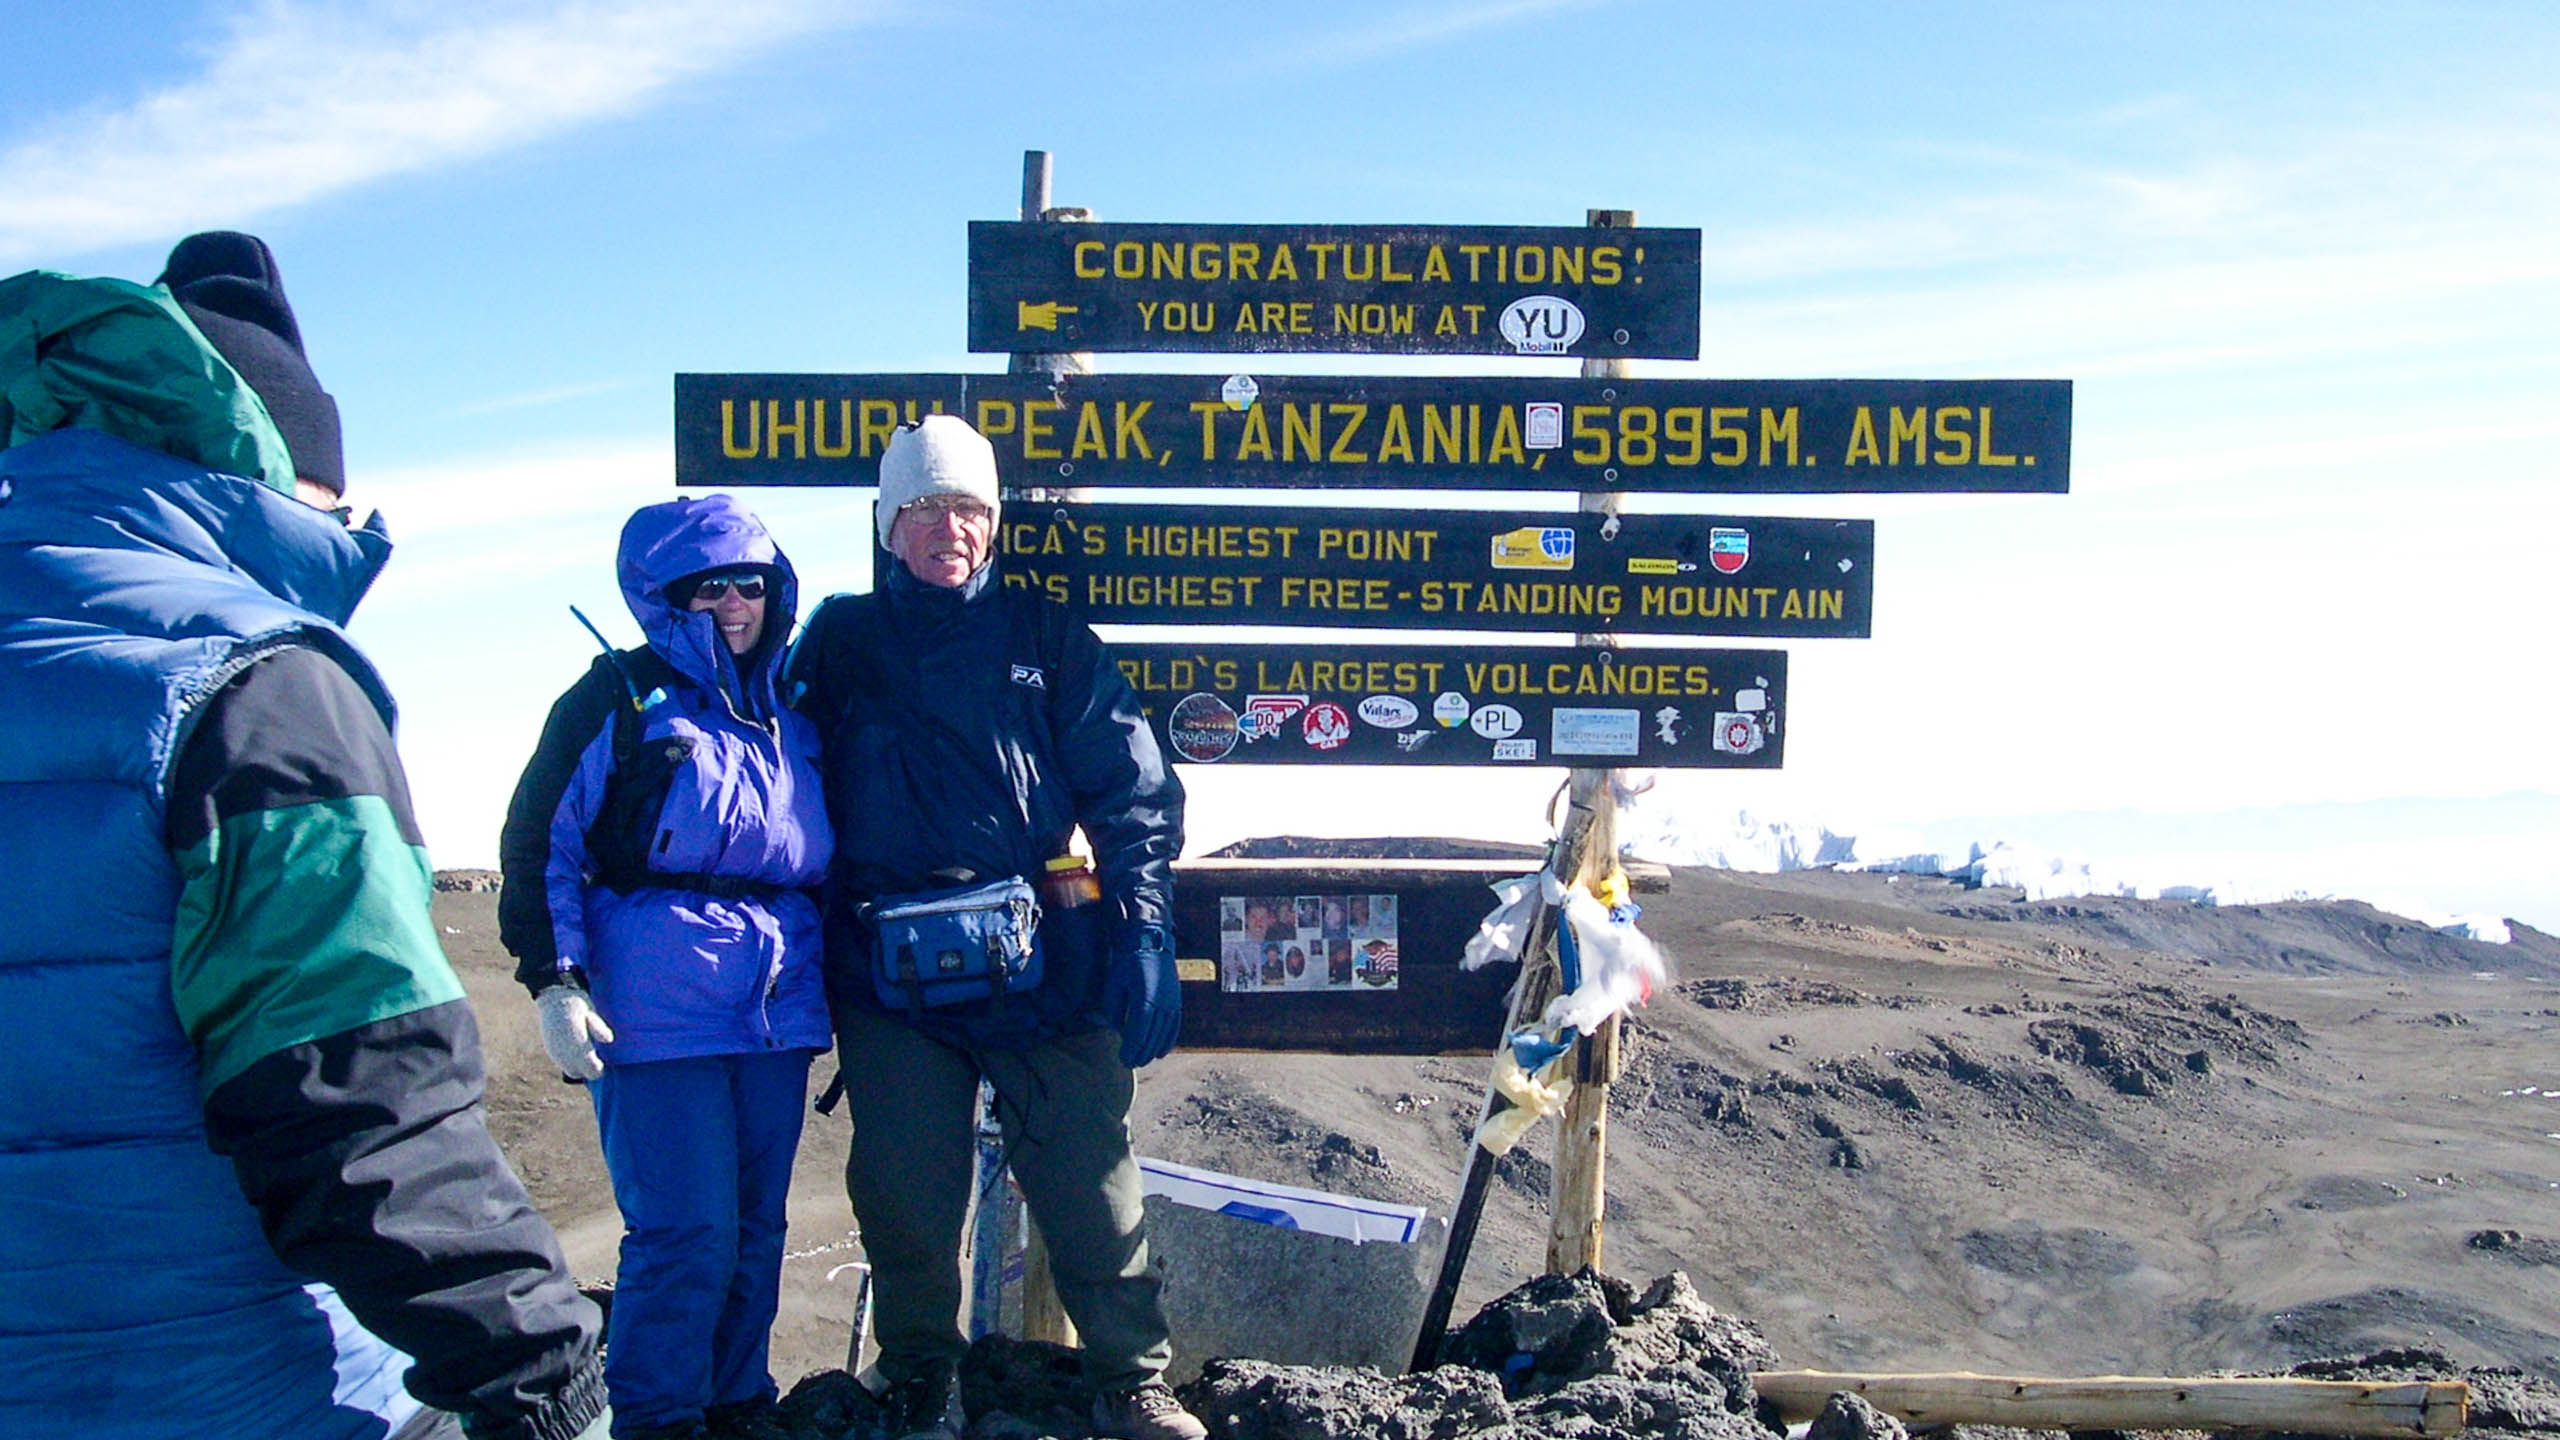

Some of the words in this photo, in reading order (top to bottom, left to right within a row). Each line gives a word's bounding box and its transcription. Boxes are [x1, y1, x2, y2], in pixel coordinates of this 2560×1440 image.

[1075, 240, 1645, 285] CONGRATULATIONS!
[1137, 301, 1215, 332] YOU
[1235, 301, 1314, 334] ARE
[1335, 302, 1415, 335] NOW
[1434, 304, 1486, 336] AT
[1516, 308, 1569, 339] YU
[722, 399, 943, 459] UHUR
[978, 399, 1172, 467] PEAK,
[1190, 399, 1547, 470] TANZANIA,
[1572, 405, 1817, 467] 5895M.
[1845, 405, 2036, 466] AMSL.
[1127, 525, 1299, 557] HIGHEST
[1319, 528, 1438, 561] POINT
[1089, 575, 1261, 606] HIGHEST
[1281, 577, 1622, 615] FREE-STANDING
[1641, 584, 1843, 619] MOUNTAIN
[1013, 667, 1045, 689] PA
[1118, 655, 1238, 690] RLD'S
[1257, 660, 1443, 693] LARGEST
[1466, 663, 1720, 696] VOLCANOES.
[1485, 710, 1515, 732] PL
